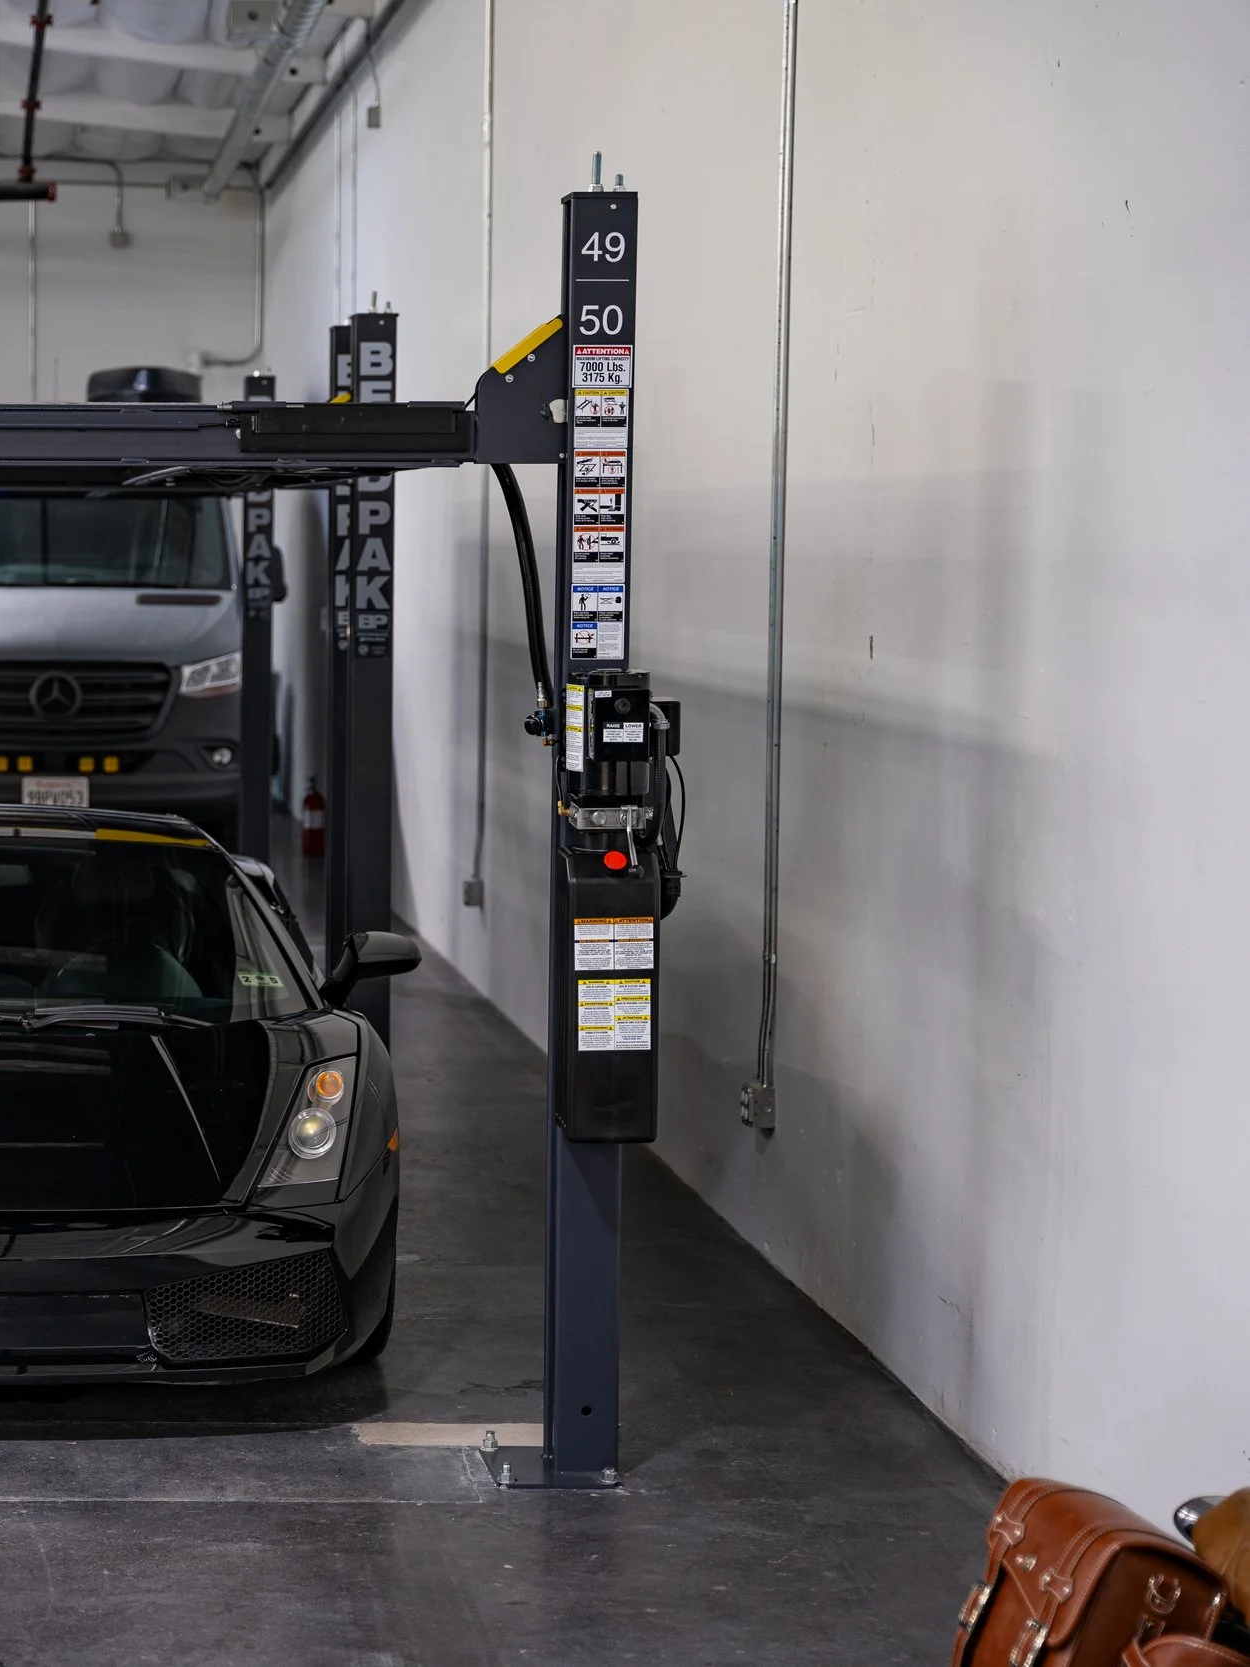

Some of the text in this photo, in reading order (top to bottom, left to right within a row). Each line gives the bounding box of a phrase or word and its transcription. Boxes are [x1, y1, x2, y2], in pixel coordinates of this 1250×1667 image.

[581, 231, 626, 262] 49
[579, 304, 624, 335] 50
[580, 362, 626, 372] 7000 Lbs.
[582, 372, 623, 384] 3175 Kg.
